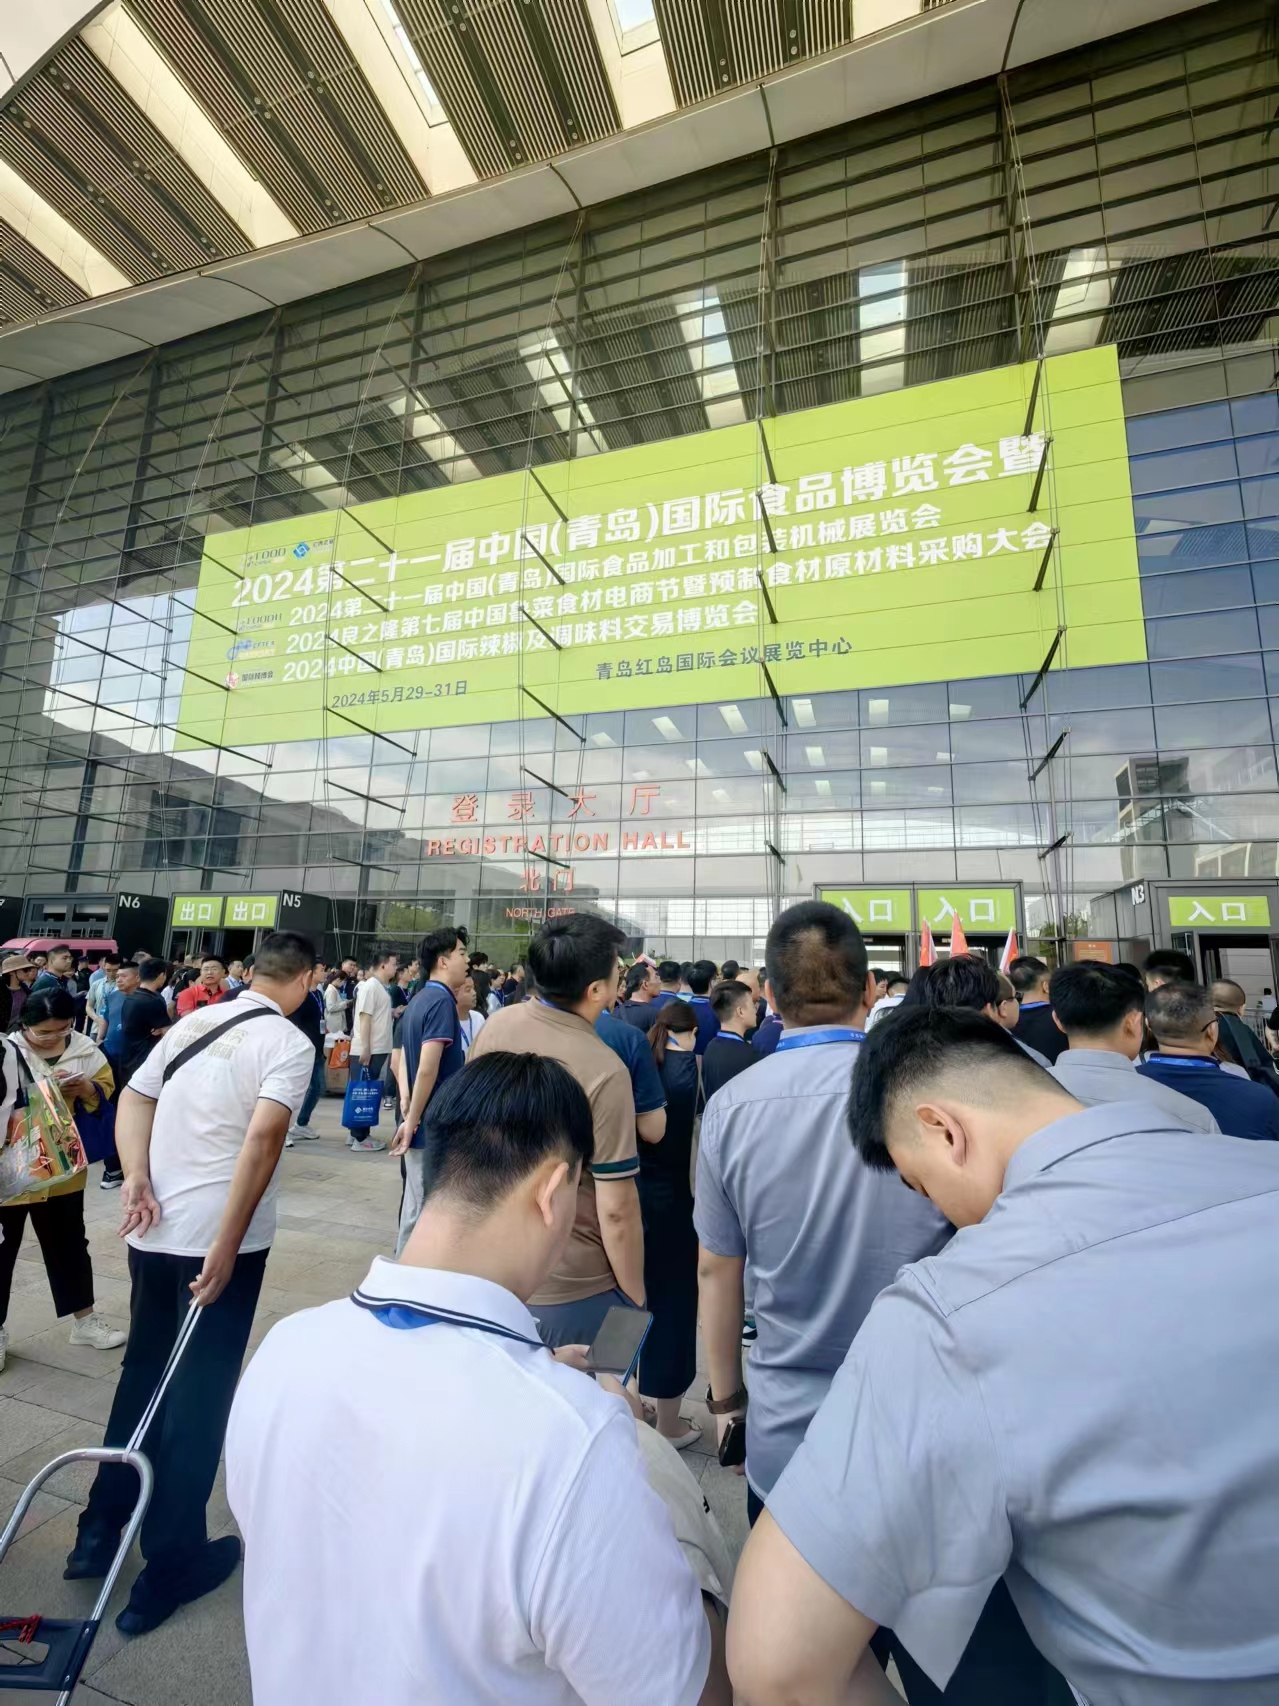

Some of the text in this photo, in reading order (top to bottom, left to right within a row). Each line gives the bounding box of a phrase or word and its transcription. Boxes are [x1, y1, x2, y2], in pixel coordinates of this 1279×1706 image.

[595, 636, 852, 681] 青岛红岛国际会议展览中心
[331, 680, 468, 709] 2024年5月29-31日
[451, 785, 660, 823] 登录大厅
[427, 830, 691, 857] REGISTRATION HALL
[519, 866, 575, 893] 北门
[119, 895, 141, 909] N6
[282, 893, 302, 908] N5
[1131, 884, 1146, 906] N3
[179, 901, 213, 922] 出口
[232, 901, 266, 922] 出口
[505, 907, 543, 918] NORTH
[842, 897, 893, 923] 入口
[933, 896, 995, 923] 入口
[1187, 900, 1247, 922] 入口
